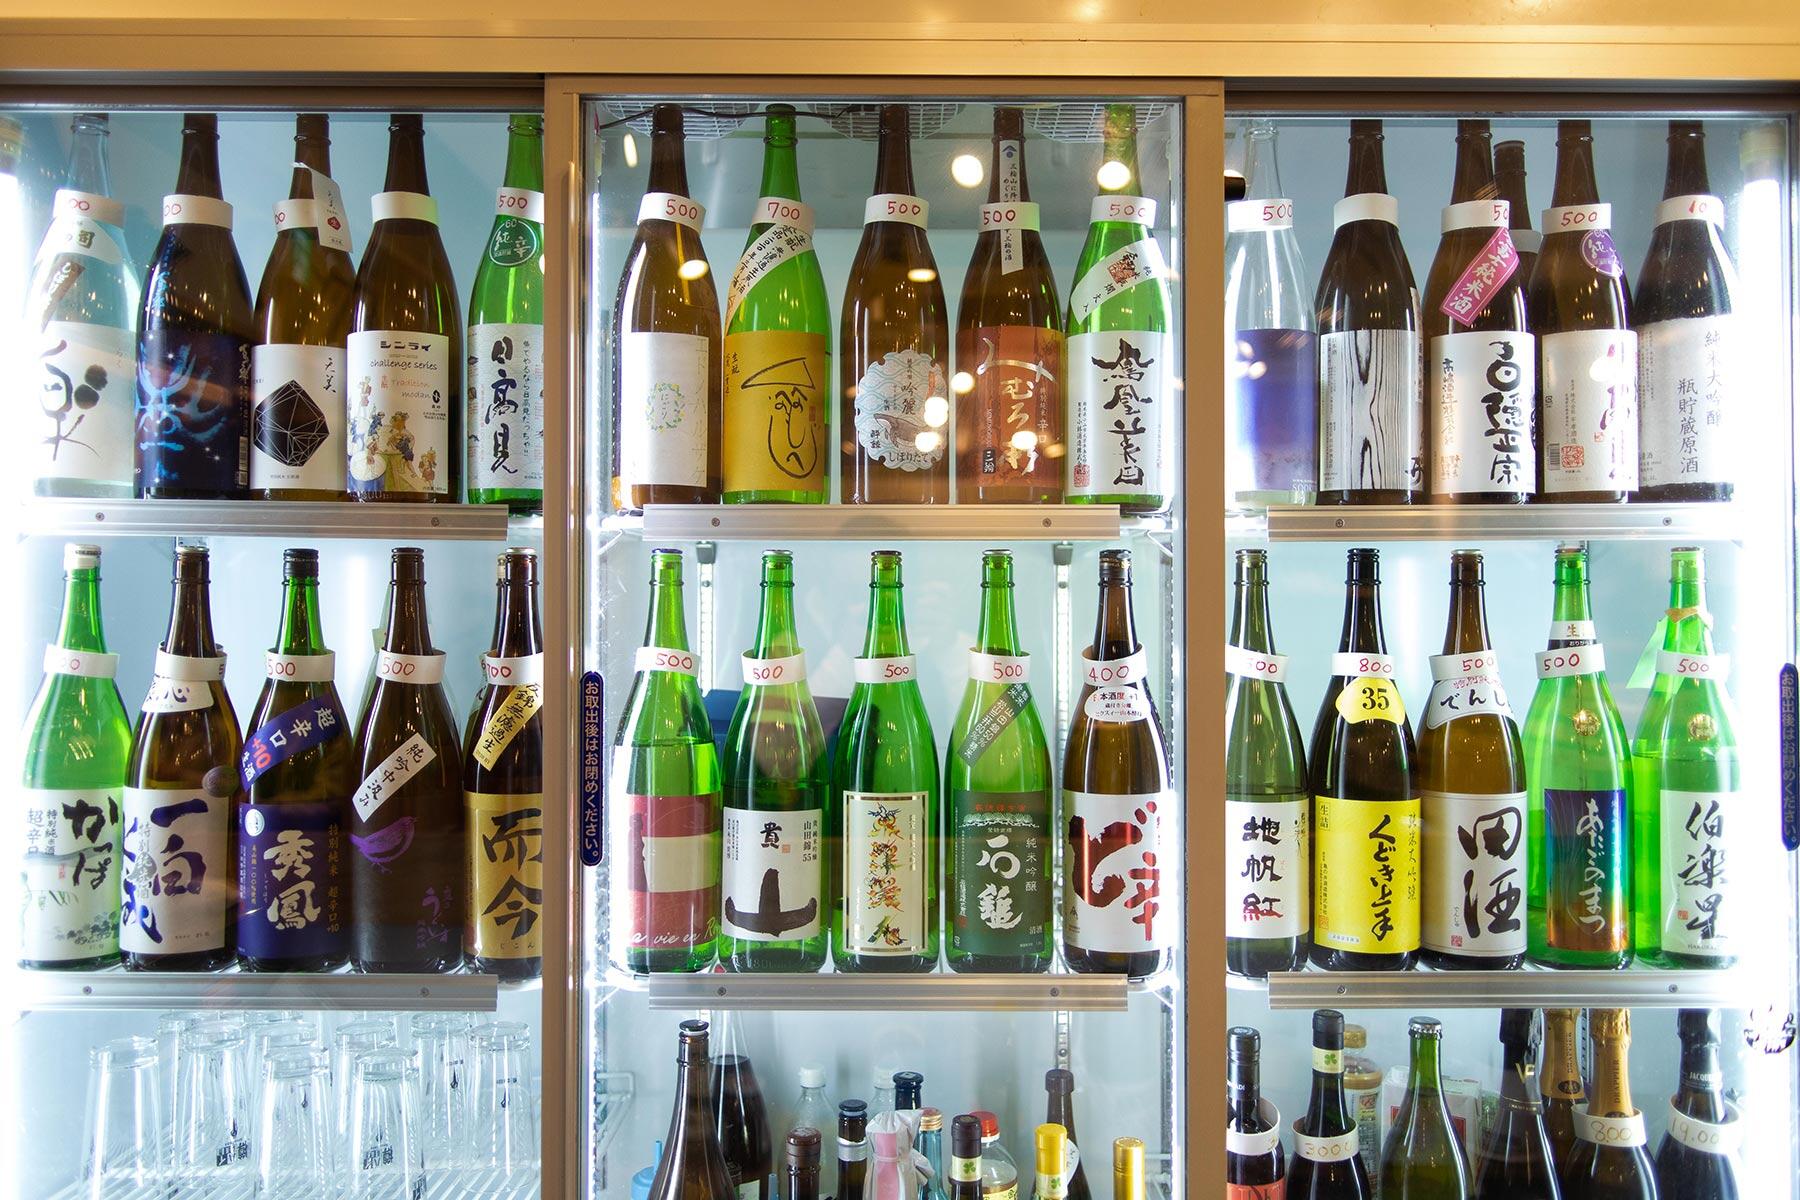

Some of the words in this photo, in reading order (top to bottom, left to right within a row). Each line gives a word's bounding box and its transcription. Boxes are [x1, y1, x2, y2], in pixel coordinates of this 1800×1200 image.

[499, 194, 528, 209] 500
[666, 199, 698, 219] 500
[767, 202, 800, 220] 700
[887, 201, 921, 215] 500
[983, 209, 1016, 225] 500
[1560, 211, 1598, 227] 500
[379, 340, 432, 352] シンライ
[369, 358, 412, 371] challenge
[413, 360, 439, 371] series
[322, 357, 337, 394] 天美
[1704, 330, 1722, 427] 純米大吟醸
[484, 336, 519, 474] 日高見
[1091, 338, 1154, 486] 鳳凰美田
[1036, 420, 1049, 443] 辛口
[1678, 378, 1699, 474] 瓶貯蔵原酒
[888, 450, 929, 463] しぼりたて
[1566, 623, 1578, 636] 生
[266, 658, 296, 676] 500
[381, 657, 416, 676] 500
[656, 654, 693, 670] 500
[884, 664, 910, 678] 500
[993, 660, 1023, 680] 500
[1359, 658, 1392, 673] 800
[1462, 656, 1494, 672] 500
[1543, 653, 1580, 671] 500
[1677, 658, 1710, 673] 500
[752, 665, 783, 680] 500
[1088, 665, 1130, 682] 400
[1361, 686, 1391, 711] 35
[1440, 688, 1507, 710] でんし
[268, 706, 336, 749] 超辛口
[251, 737, 272, 769] +10
[358, 742, 425, 808] 純吟中汲み
[584, 680, 600, 857] お取出後はお閉めください。
[27, 808, 44, 855] 超辛口
[760, 821, 783, 849] 貴
[1025, 836, 1038, 892] 純米吟醸
[1457, 806, 1523, 939] 田酒
[1576, 798, 1606, 935] あたごのまつ
[1676, 800, 1729, 940] 伯楽星
[263, 829, 322, 930] 秀鳳
[481, 808, 543, 941] 而今
[1368, 814, 1397, 942] くどき上手
[653, 930, 680, 945] vie
